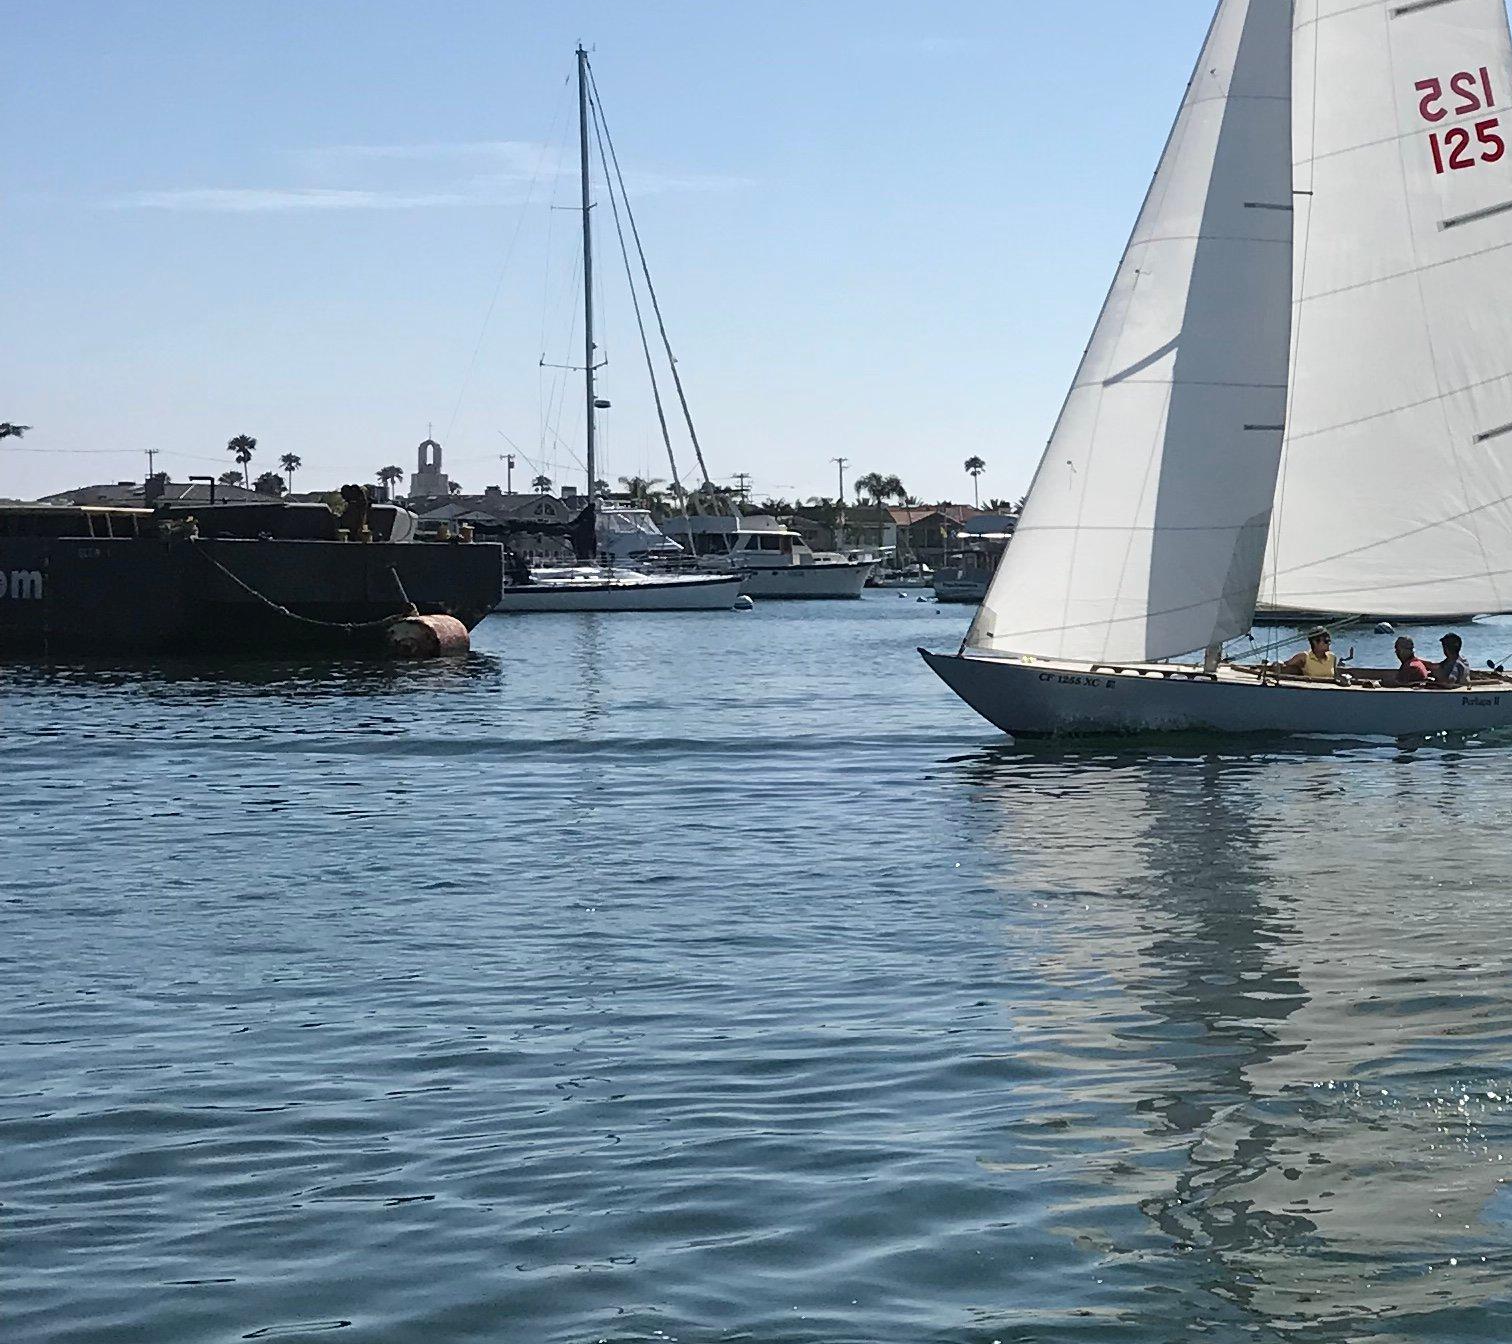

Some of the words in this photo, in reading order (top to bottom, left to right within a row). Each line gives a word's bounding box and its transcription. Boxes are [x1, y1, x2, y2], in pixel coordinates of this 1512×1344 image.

[1429, 118, 1505, 174] 125
[1039, 673, 1054, 682] CF
[1083, 677, 1101, 688] XC
